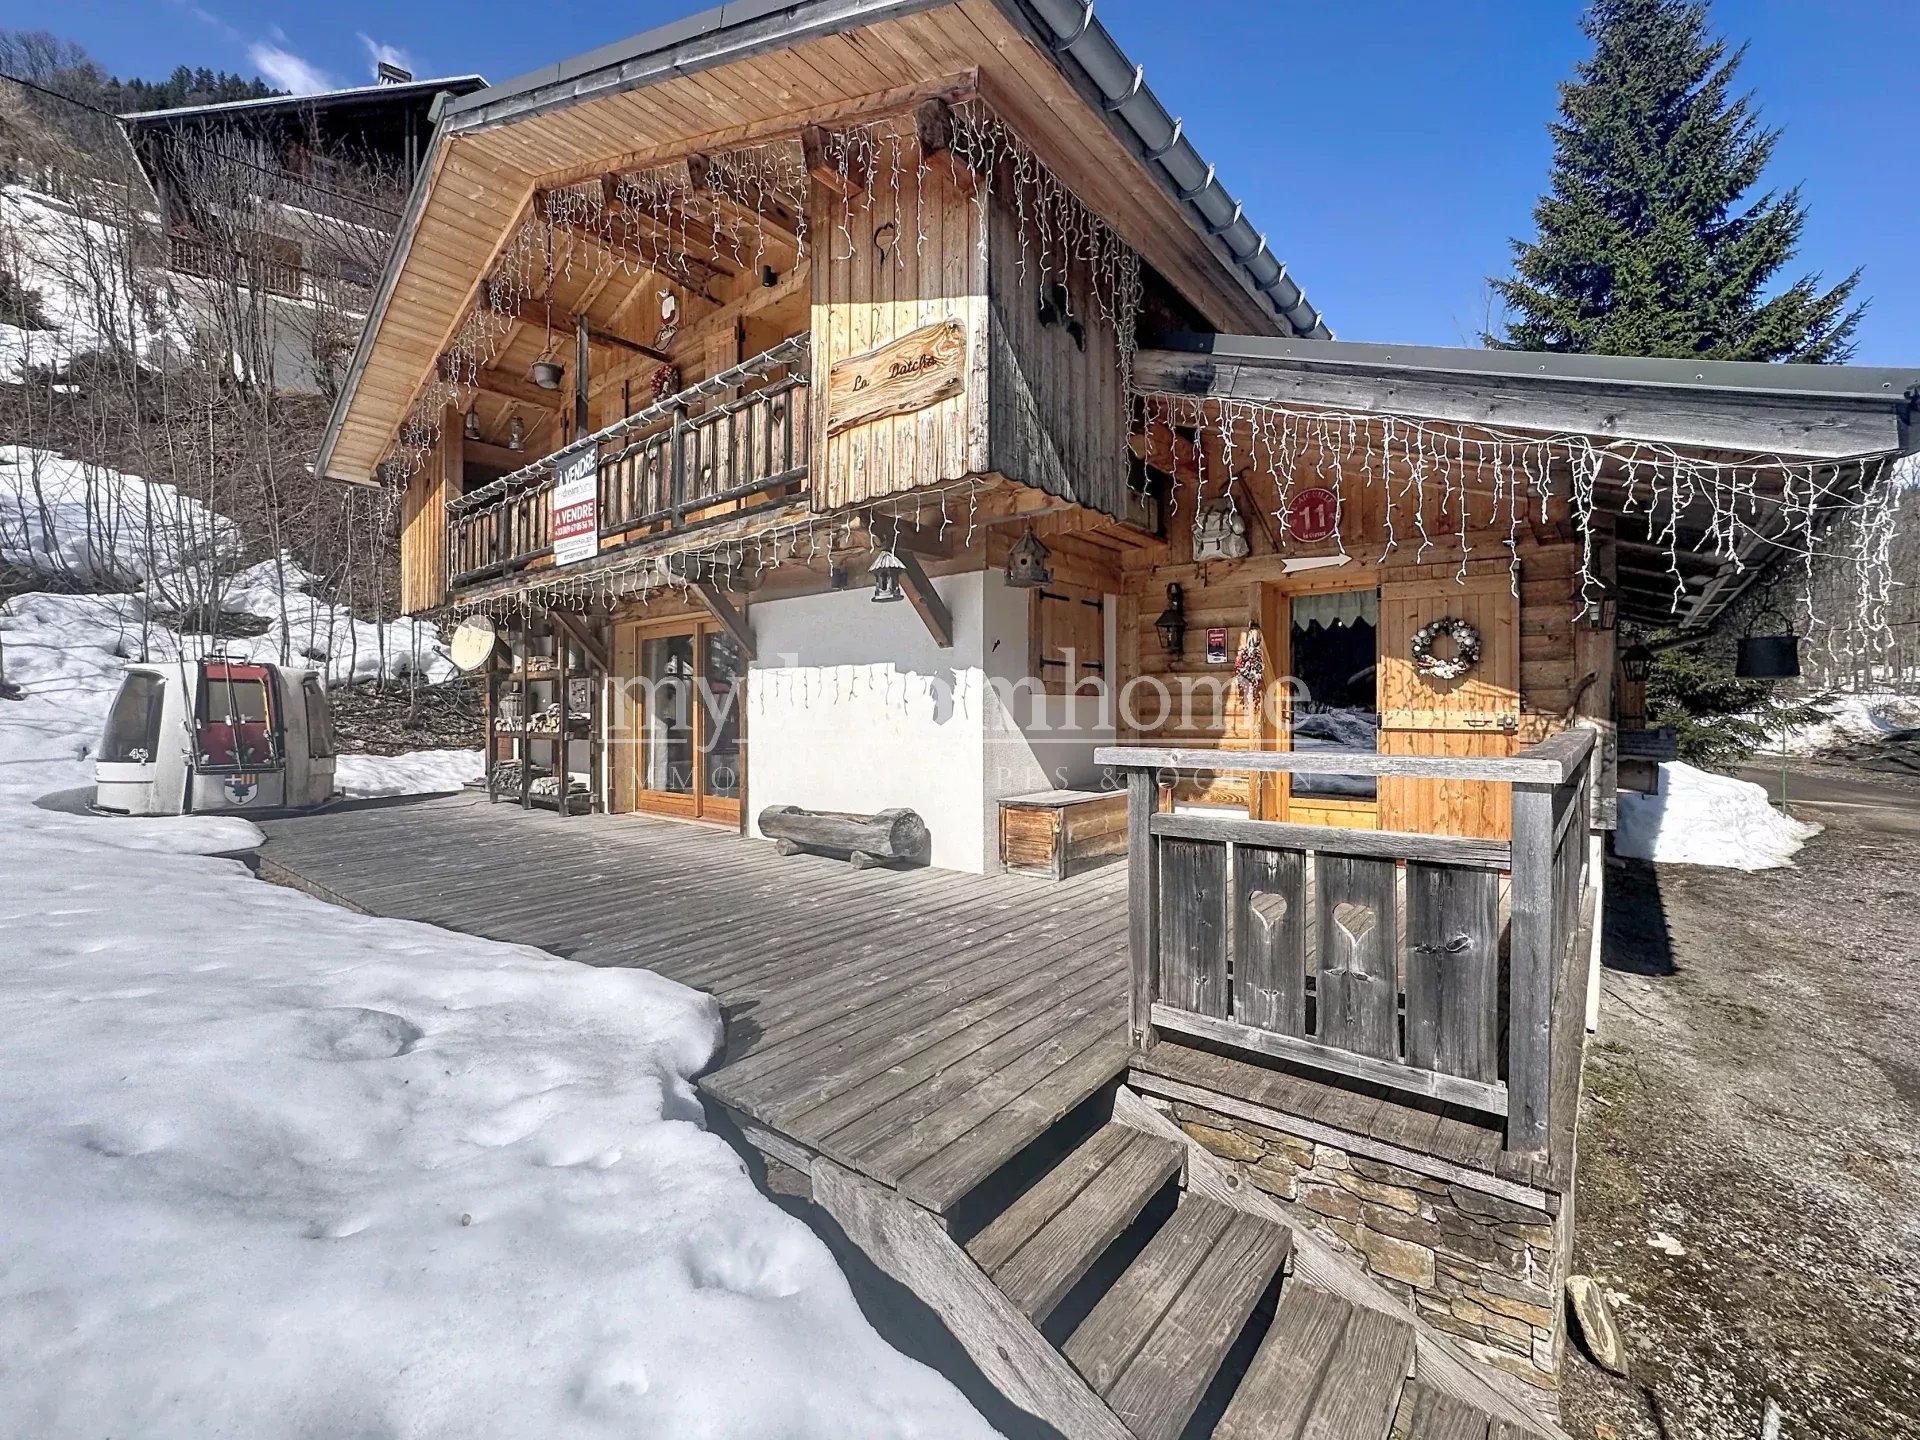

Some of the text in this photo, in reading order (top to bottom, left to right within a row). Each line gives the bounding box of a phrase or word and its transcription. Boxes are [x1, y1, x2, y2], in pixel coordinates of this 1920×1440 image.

[852, 375, 870, 392] La
[565, 449, 596, 484] VENDRE
[562, 502, 594, 524] VENDRE
[1299, 503, 1326, 530] 11
